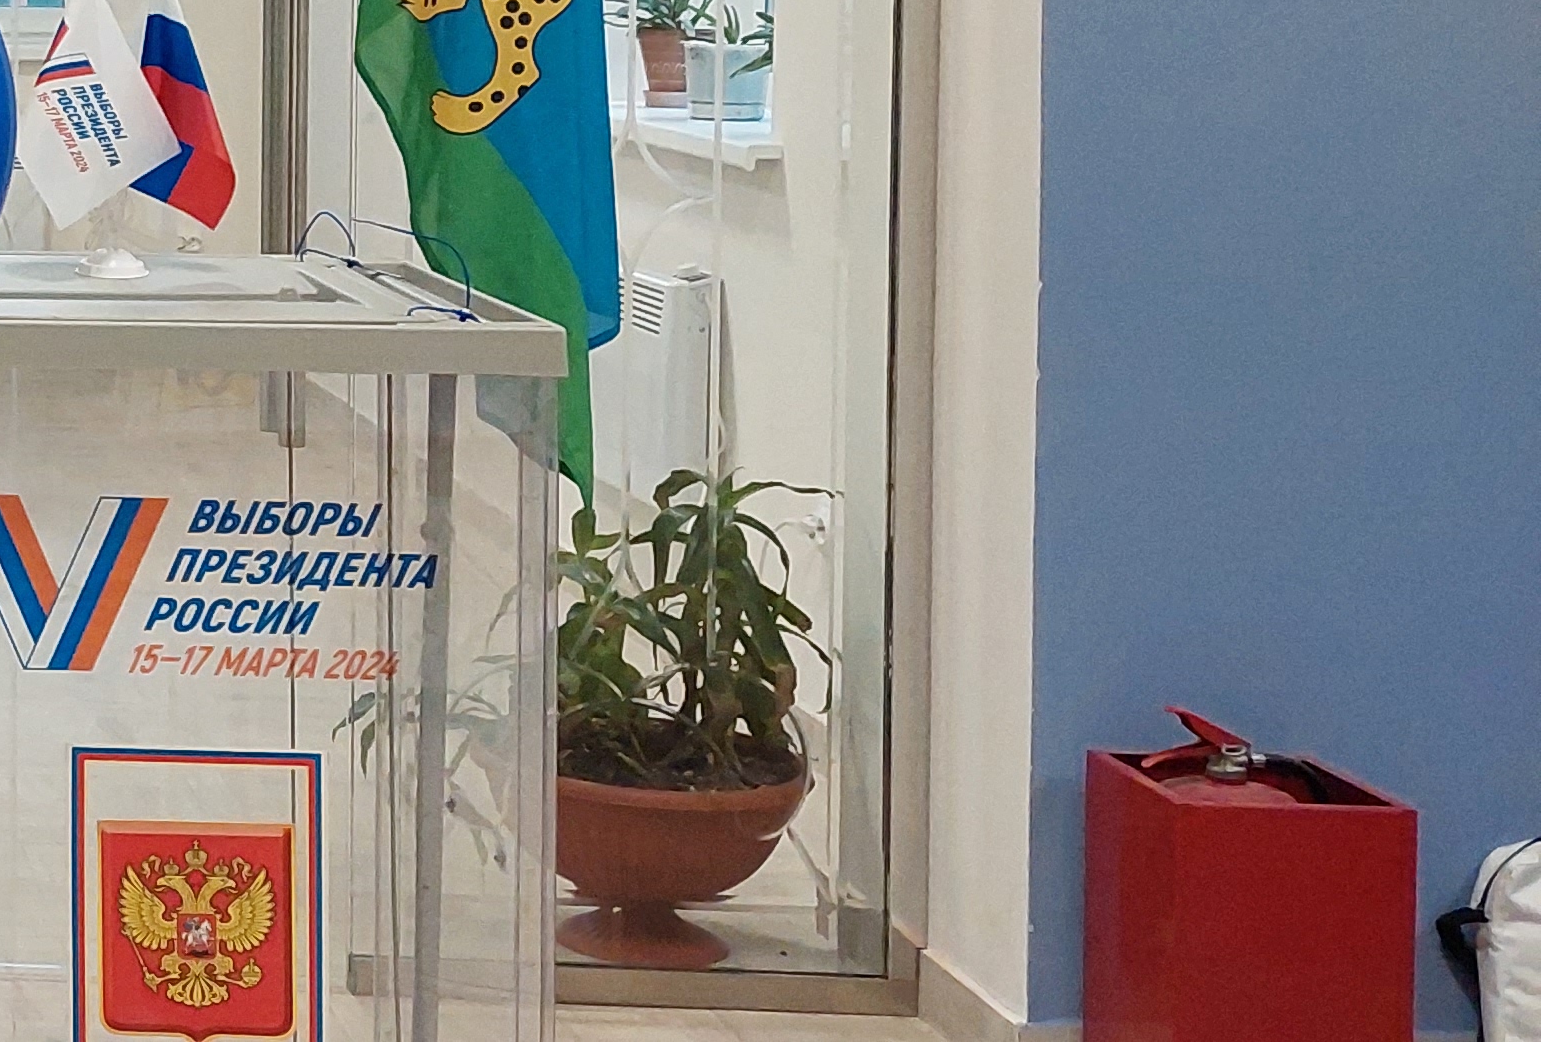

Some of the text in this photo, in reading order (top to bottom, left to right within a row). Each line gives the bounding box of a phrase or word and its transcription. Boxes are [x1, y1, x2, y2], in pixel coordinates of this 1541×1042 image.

[51, 88, 92, 140] РОССИИ
[70, 85, 122, 167] ПРЕЗИДЕНТА
[88, 83, 128, 140] ВЫБОРЫ
[50, 117, 78, 150] МАРТА
[69, 150, 90, 173] 2024
[187, 498, 384, 538] ВЫБОРЫ
[164, 547, 439, 592] ПРЕЗИДЕНТА
[143, 596, 321, 636] РОССИИ
[213, 645, 321, 680] МАРТА
[323, 648, 401, 682] 2024
